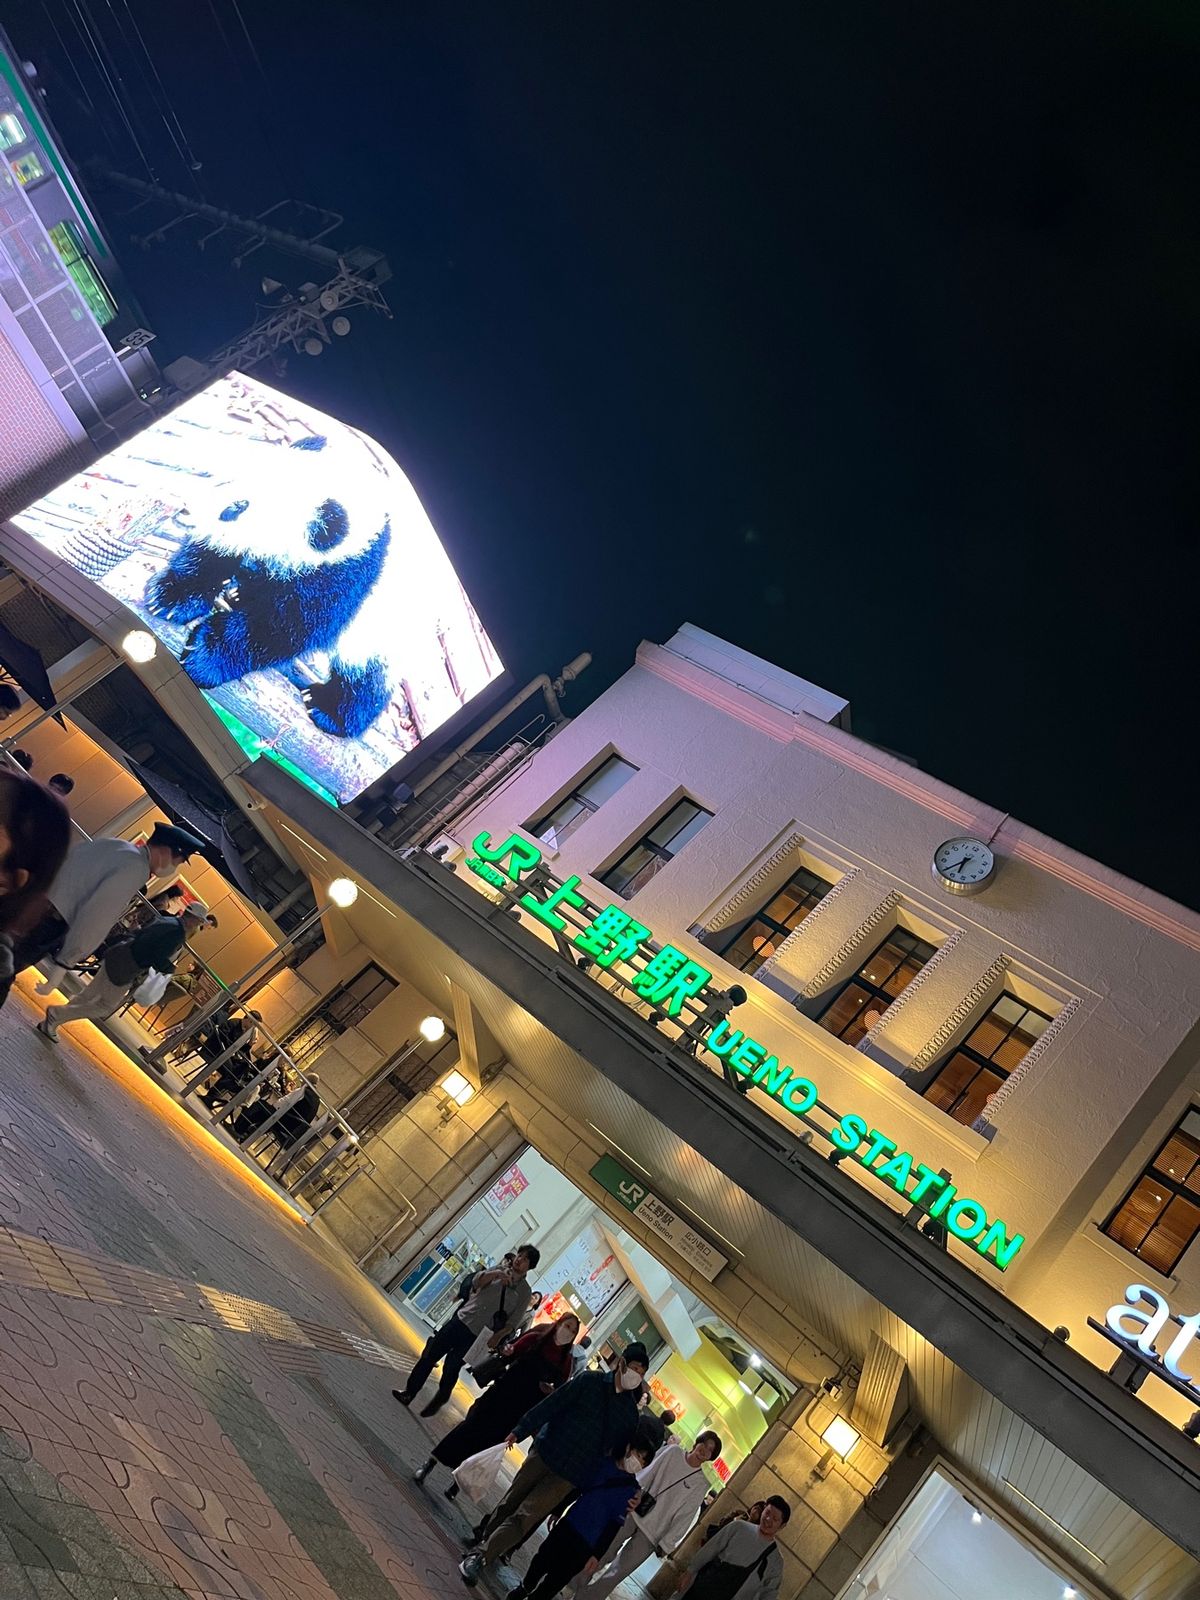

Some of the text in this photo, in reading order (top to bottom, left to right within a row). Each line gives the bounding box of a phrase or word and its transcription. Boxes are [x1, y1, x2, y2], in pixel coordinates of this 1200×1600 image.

[125, 331, 151, 346] 35
[472, 831, 1026, 1271] JR 上野駅 UENO STATION
[619, 1180, 645, 1203] JR
[638, 1206, 674, 1241] Ueno Station
[644, 1199, 675, 1226] 上野駅
